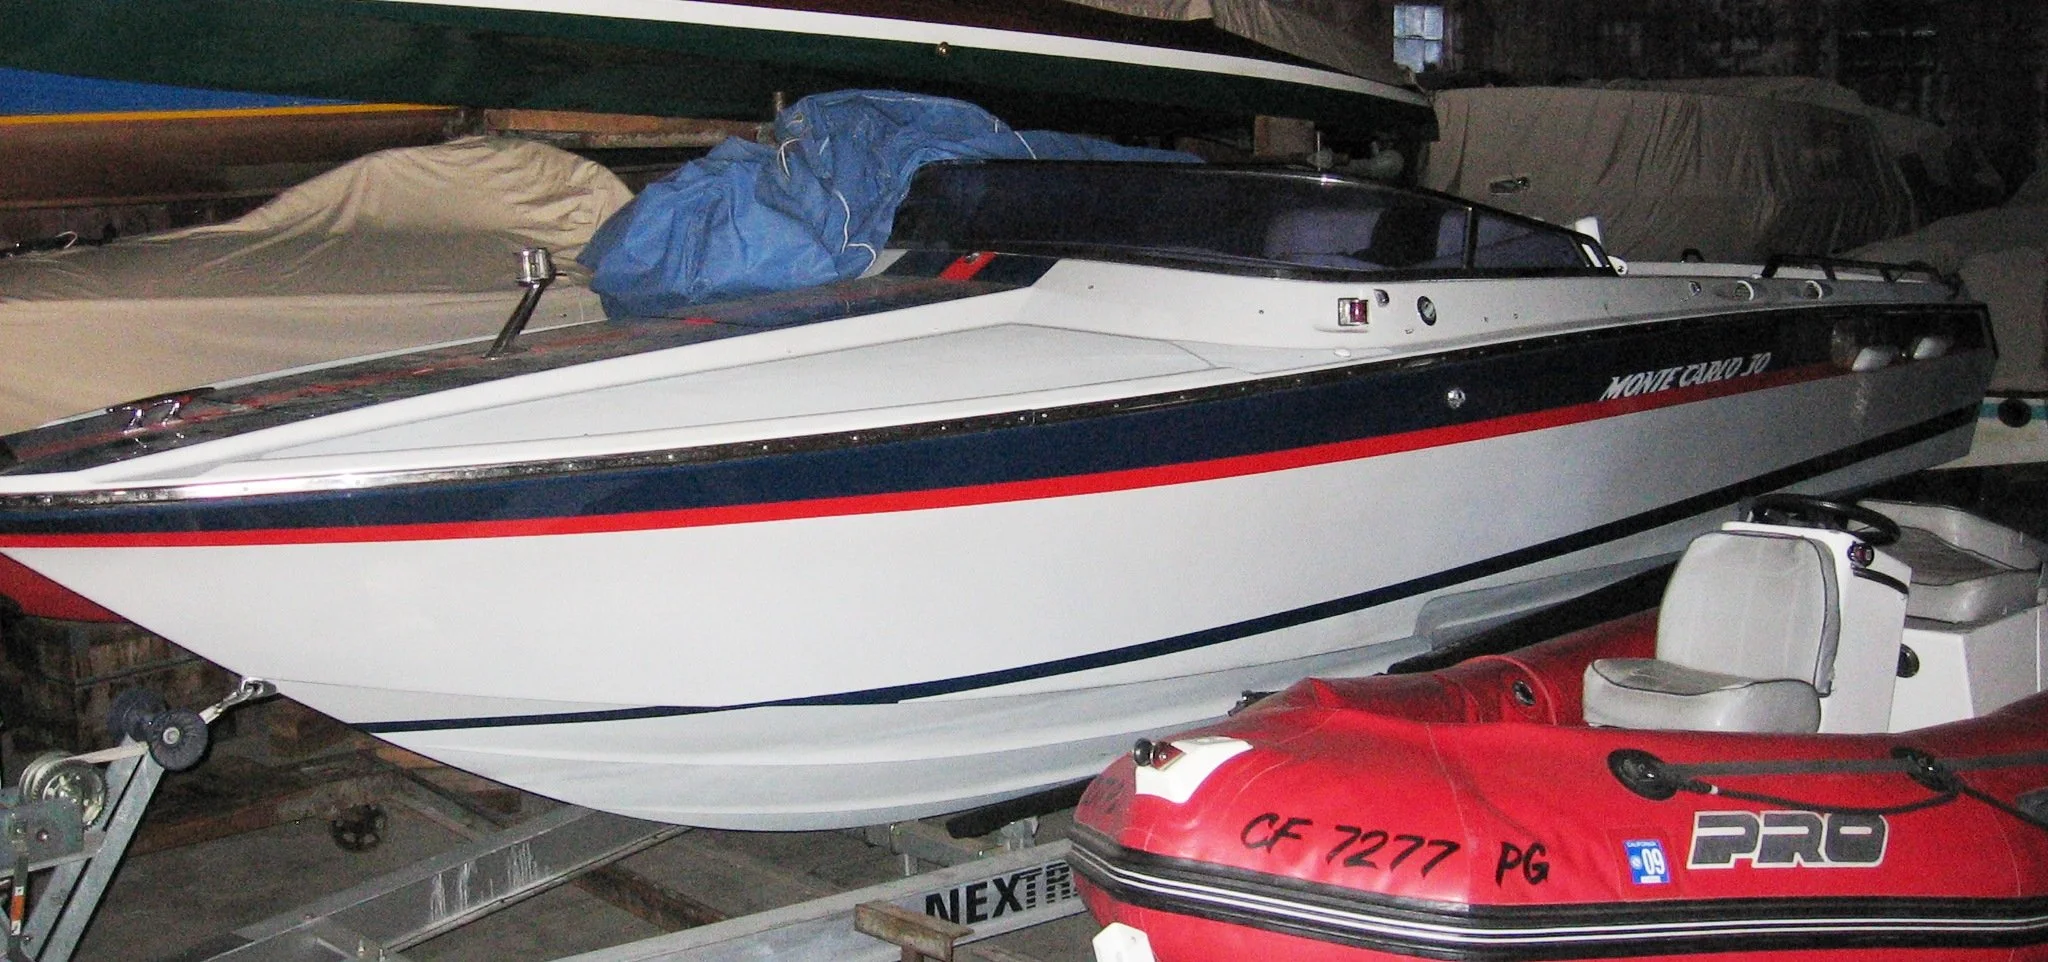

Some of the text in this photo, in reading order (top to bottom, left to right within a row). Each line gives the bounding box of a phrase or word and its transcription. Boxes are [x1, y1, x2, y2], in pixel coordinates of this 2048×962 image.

[1600, 352, 1772, 401] MONTE CARLO 30
[1240, 812, 1549, 887] CF 7277 PG
[1641, 848, 1665, 875] 09
[1686, 809, 1889, 870] PRO
[925, 862, 1078, 925] NEXTR
